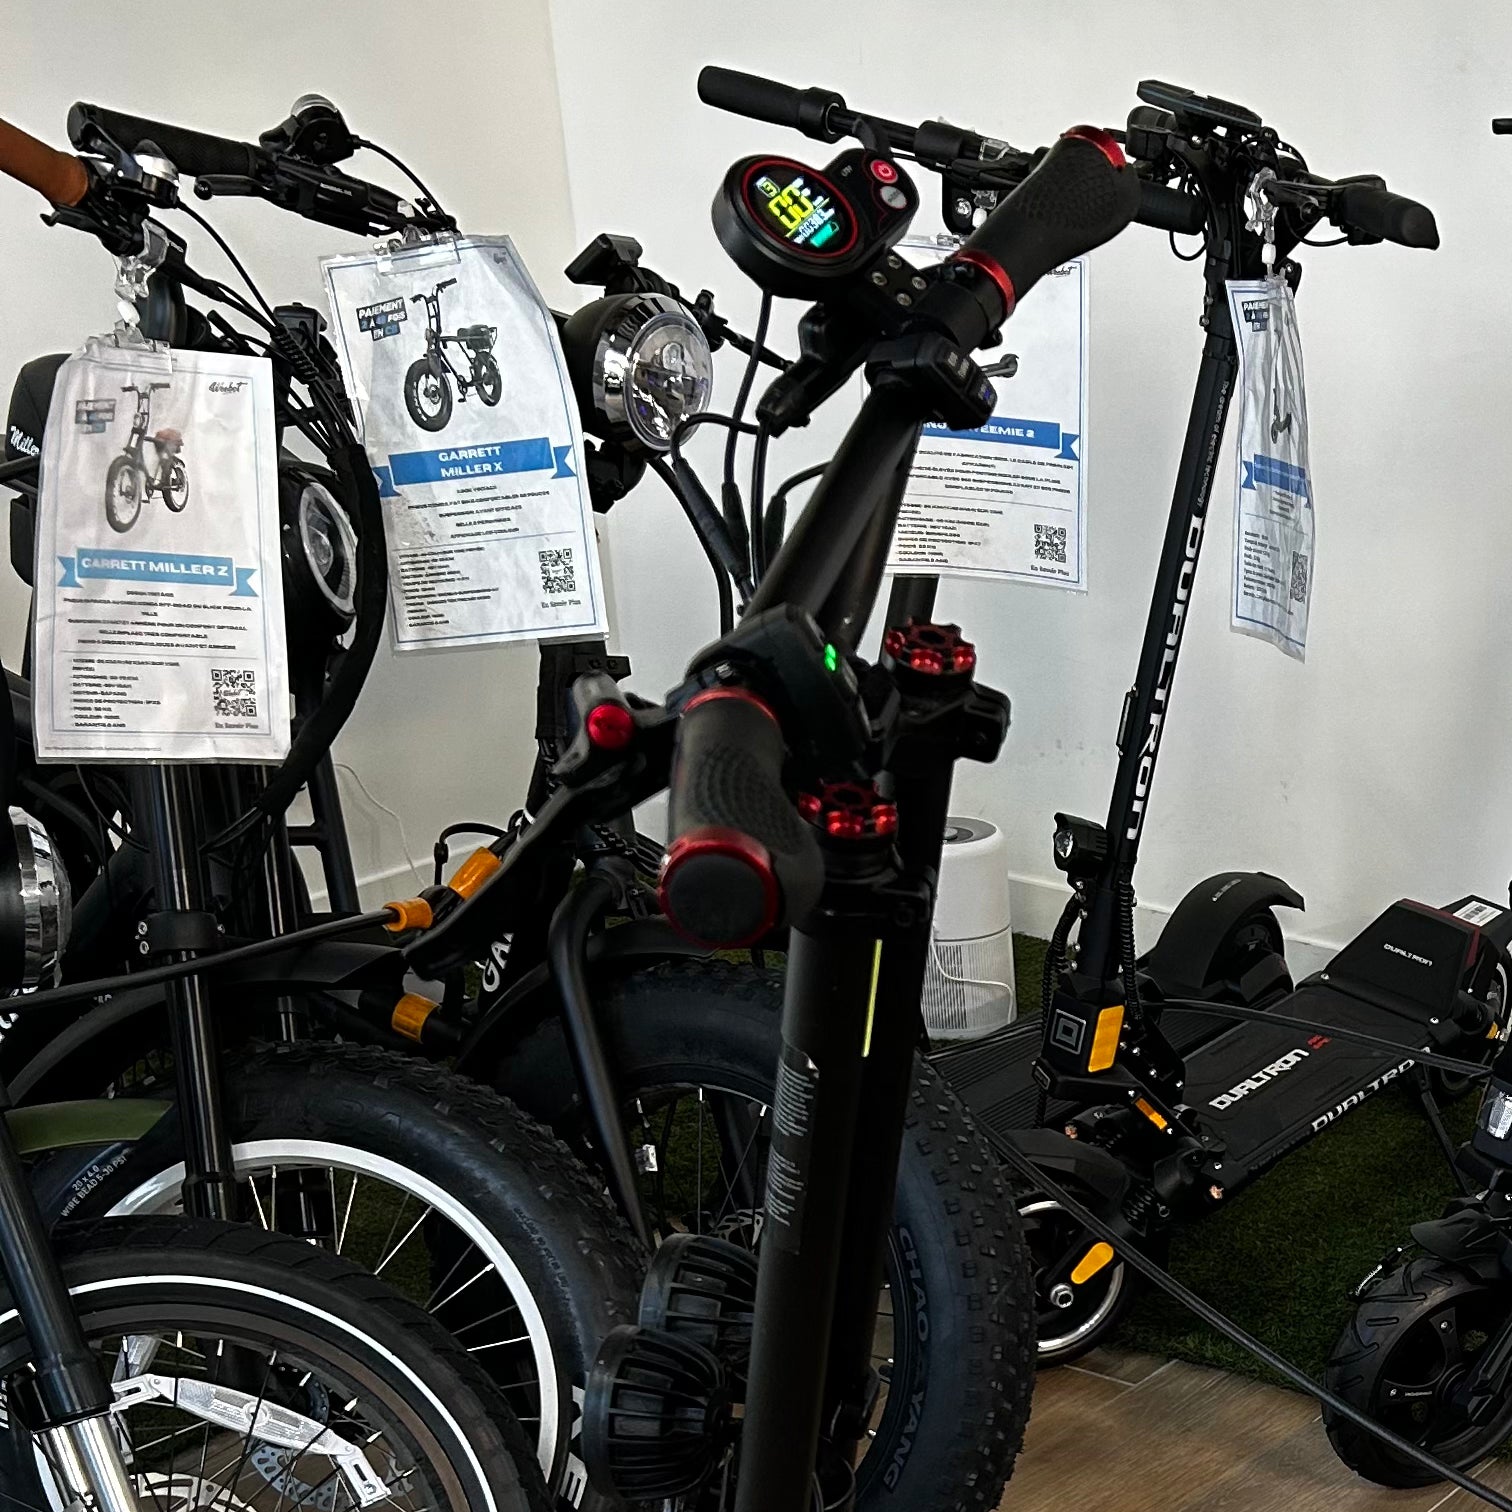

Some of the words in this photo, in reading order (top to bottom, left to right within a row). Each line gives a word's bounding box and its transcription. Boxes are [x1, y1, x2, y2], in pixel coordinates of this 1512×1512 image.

[359, 299, 403, 319] PAIEMENT
[438, 446, 502, 462] GARRETT
[440, 463, 492, 477] MILLER
[492, 461, 503, 472] X
[81, 557, 147, 572] GARRETT
[149, 560, 214, 576] MILLER
[215, 563, 228, 577] Z
[1126, 513, 1205, 840] DUALTRON
[1383, 943, 1433, 967] DUALTRON
[1208, 1048, 1310, 1111] DUALTRON
[61, 1196, 80, 1217] WIRE
[900, 1226, 929, 1342] CHAO
[883, 1390, 924, 1489] YANG
